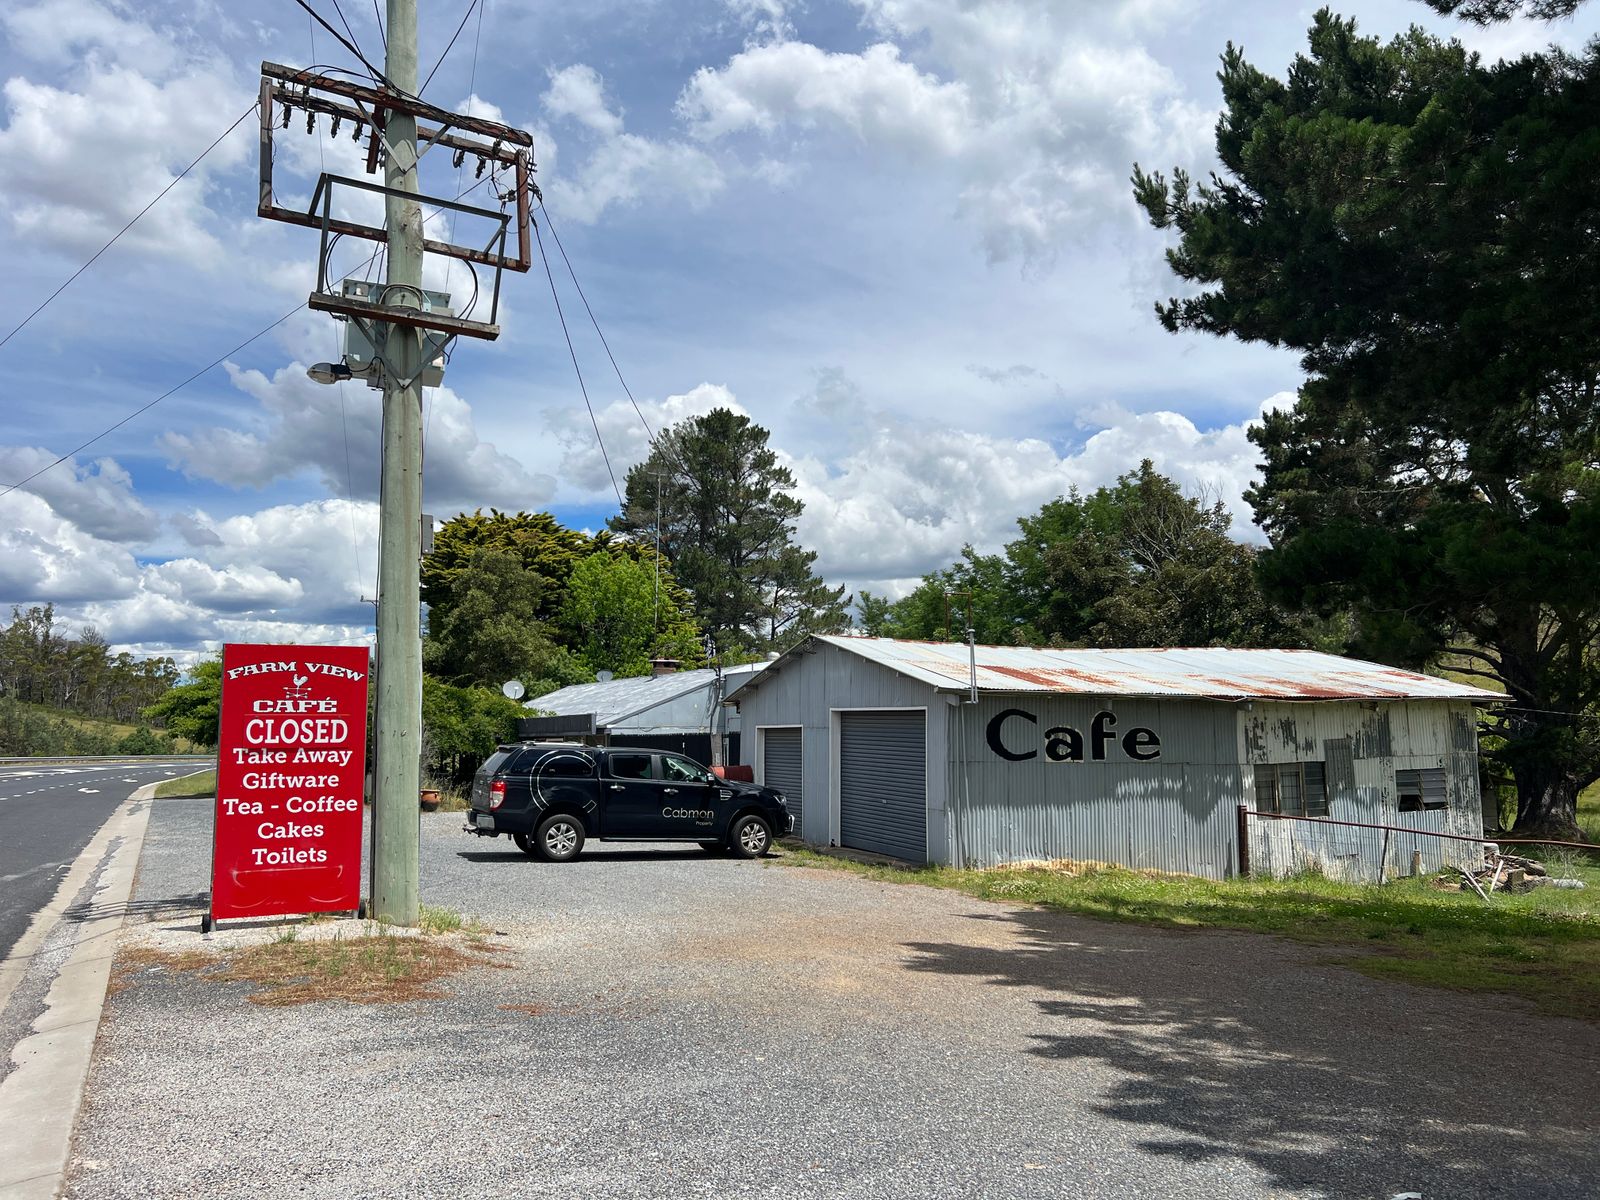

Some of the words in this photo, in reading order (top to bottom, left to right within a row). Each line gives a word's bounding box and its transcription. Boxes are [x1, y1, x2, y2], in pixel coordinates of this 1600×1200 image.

[227, 661, 297, 680] FARM
[304, 662, 365, 682] VIEW
[253, 697, 337, 713] CAFÉ
[245, 719, 348, 744] CLOSED
[986, 708, 1161, 762] Cafe
[233, 748, 287, 764] Take
[292, 747, 353, 766] Away
[242, 773, 339, 789] Giftware
[223, 798, 264, 815] Tea
[286, 796, 358, 813] Coffee
[662, 806, 714, 819] Cabmon
[257, 822, 324, 839] Cakes
[252, 847, 328, 865] Toilets
